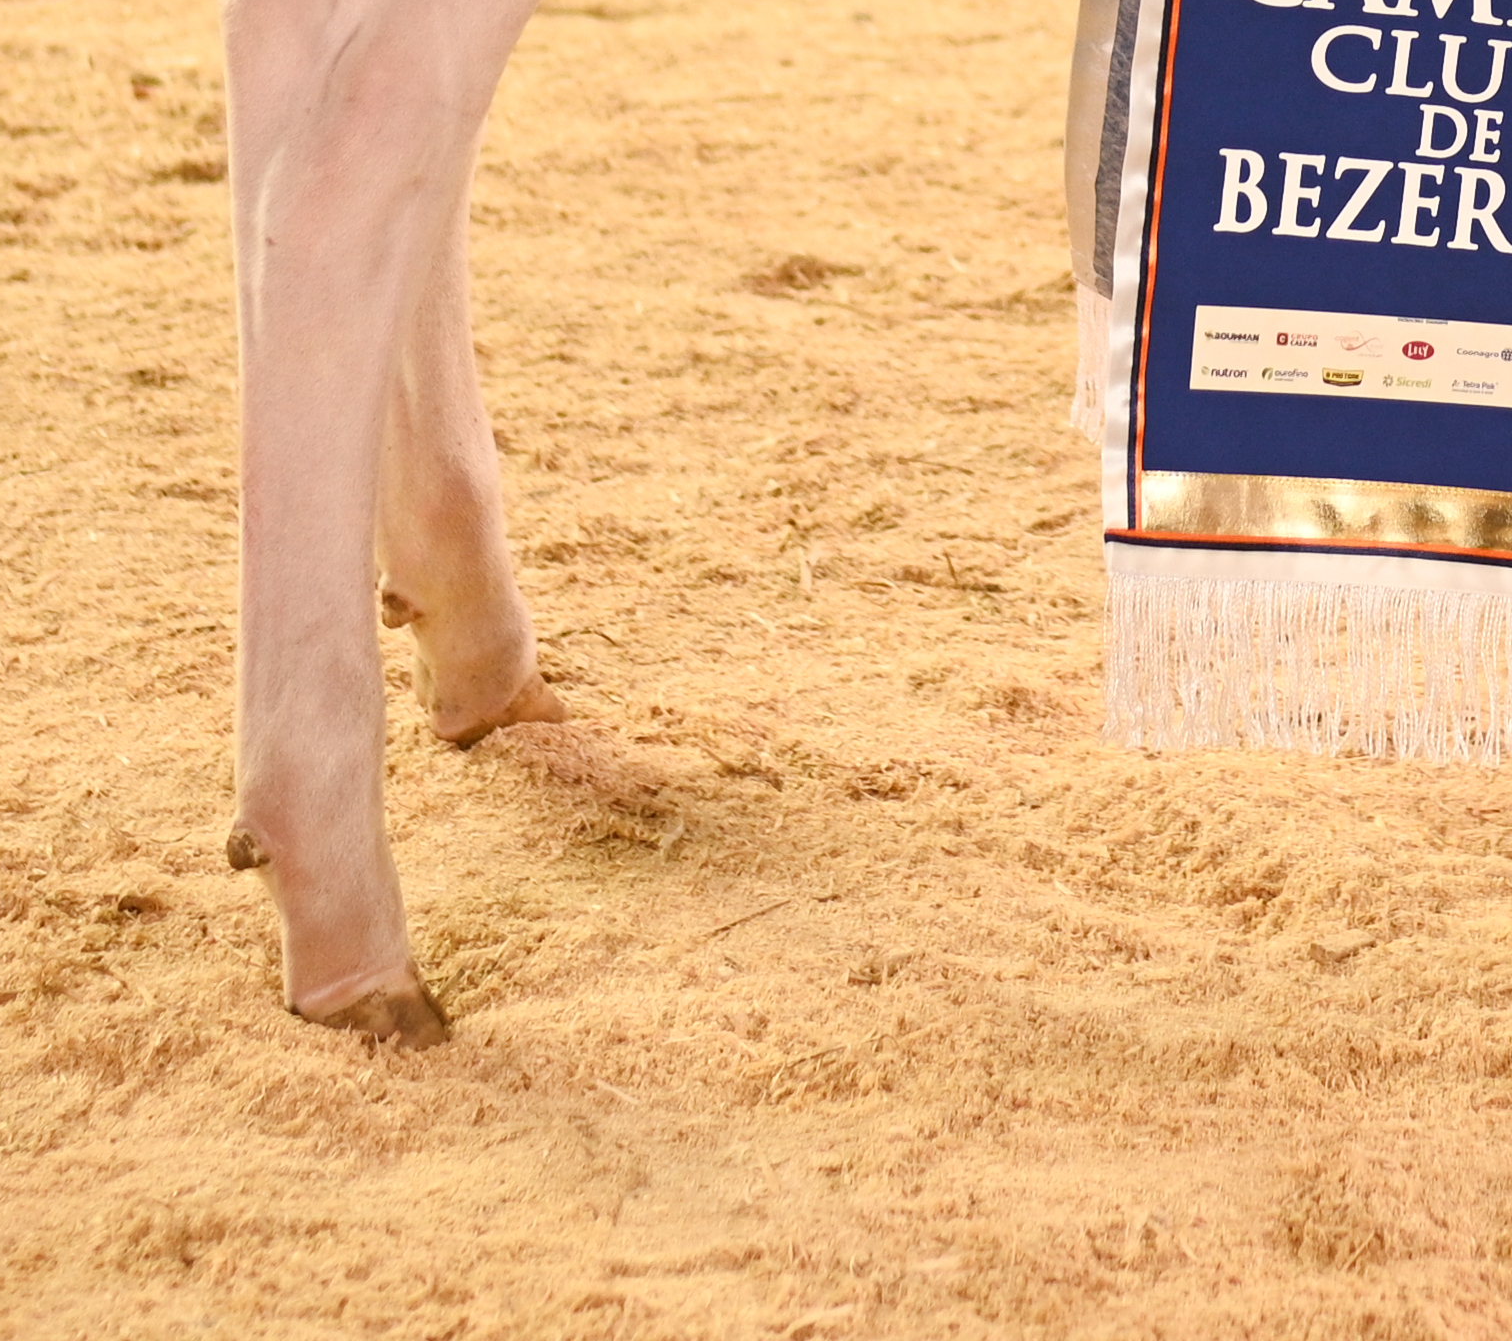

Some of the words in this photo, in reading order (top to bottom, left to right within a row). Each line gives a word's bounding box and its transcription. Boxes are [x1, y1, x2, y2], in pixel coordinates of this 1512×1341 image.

[1416, 104, 1503, 163] DE
[1291, 333, 1318, 341] GRUPO
[1456, 347, 1499, 358] Coonagro
[1211, 368, 1247, 378] nutron
[1274, 368, 1308, 378] ourofino
[1396, 376, 1432, 388] Sicredi
